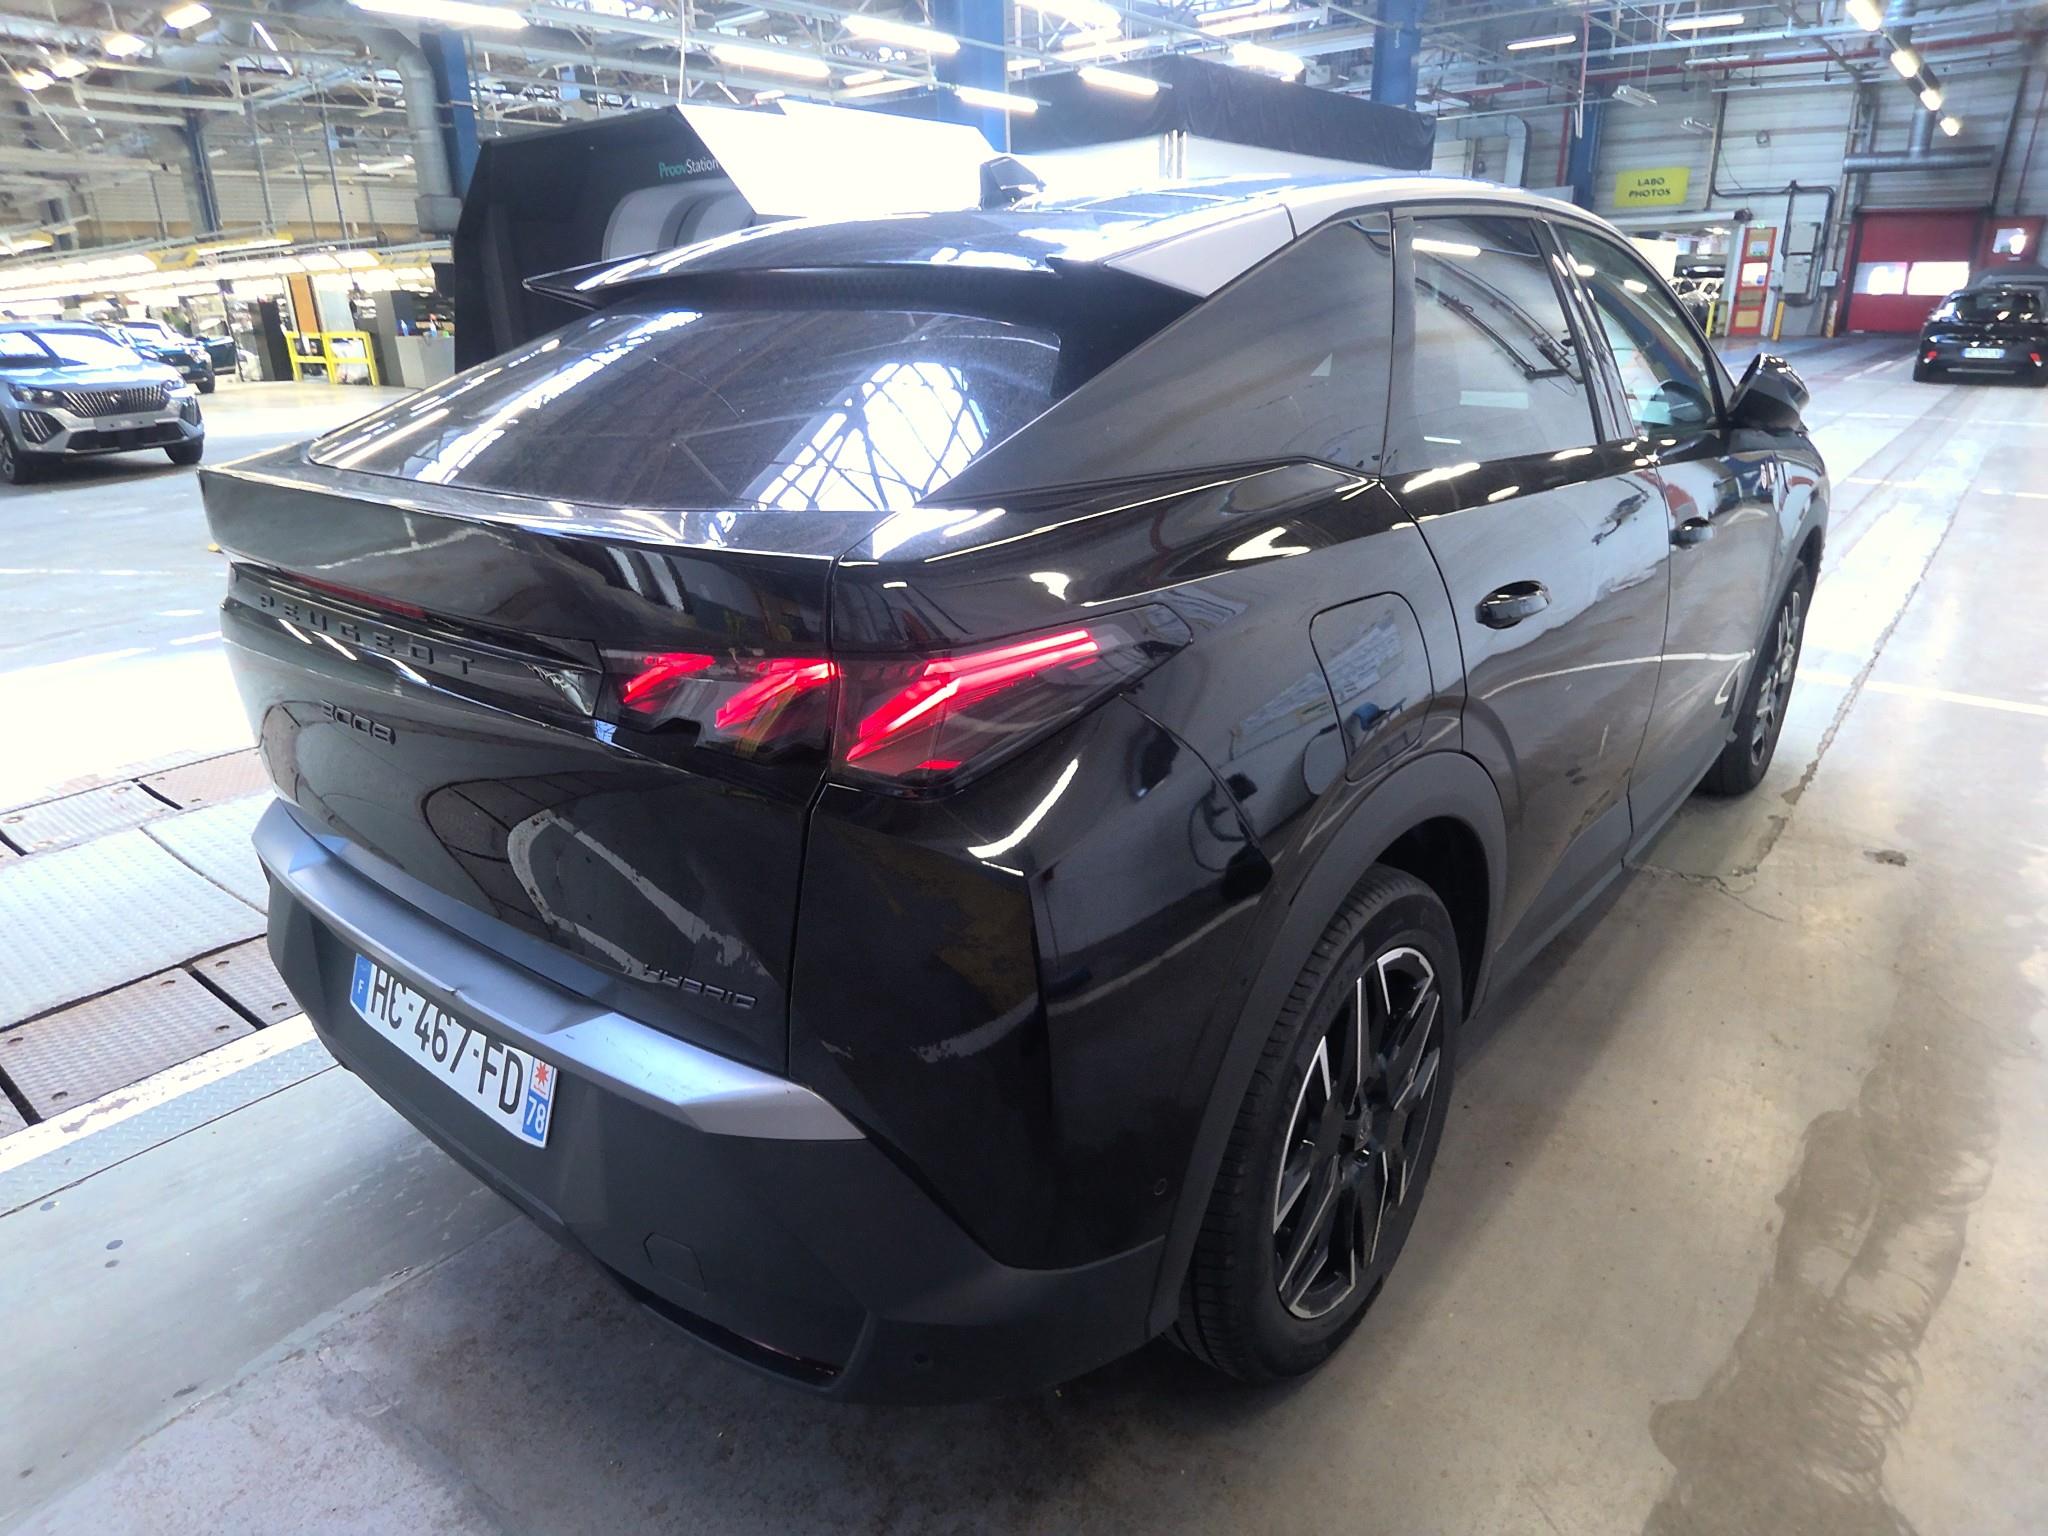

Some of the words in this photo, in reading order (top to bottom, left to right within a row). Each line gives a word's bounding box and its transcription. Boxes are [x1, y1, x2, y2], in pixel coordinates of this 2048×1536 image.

[659, 157, 720, 178] ProovStation
[1637, 177, 1665, 187] LABO
[1628, 188, 1671, 198] PHOTOS
[356, 979, 365, 995] F
[370, 964, 524, 1115] HC-467-FD
[525, 1096, 546, 1134] 78
